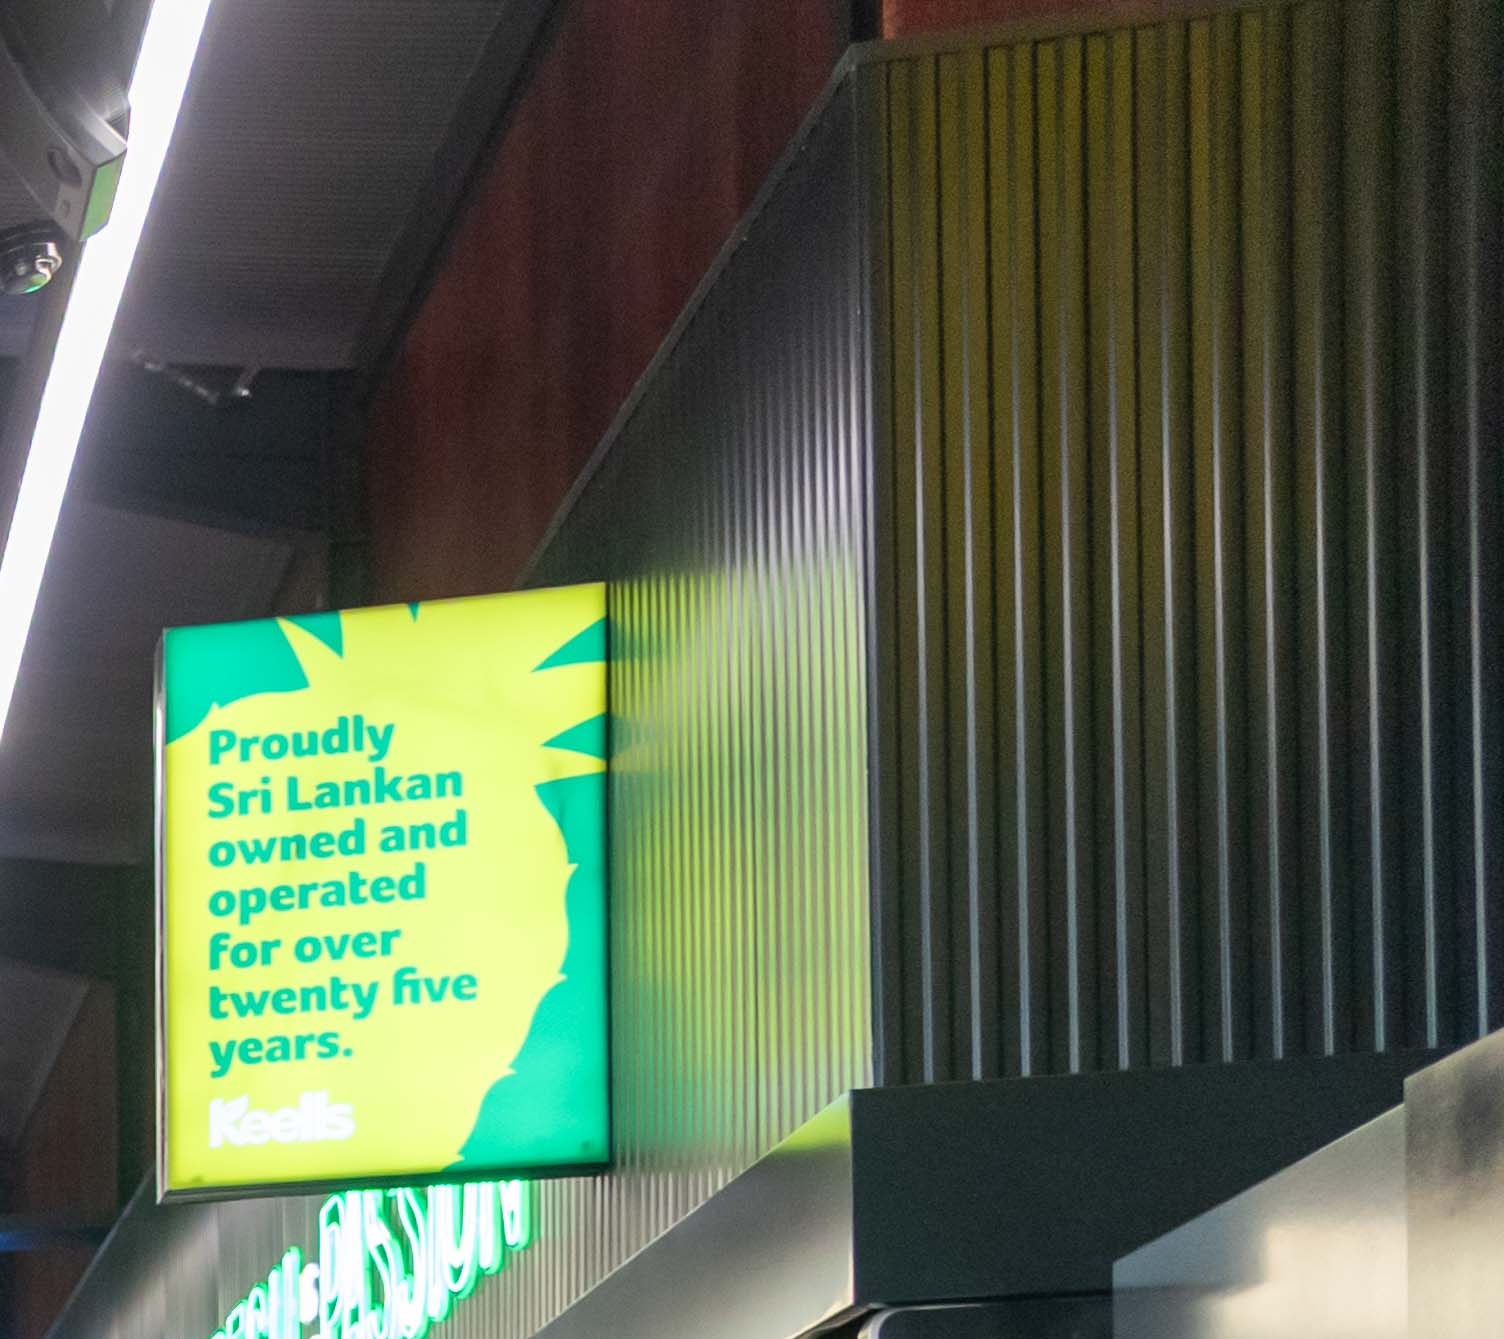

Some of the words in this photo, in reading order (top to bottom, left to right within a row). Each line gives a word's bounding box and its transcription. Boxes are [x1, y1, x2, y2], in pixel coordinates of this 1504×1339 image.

[209, 715, 395, 764] Proudly
[208, 777, 272, 819] Sri
[287, 766, 464, 811] Lankan
[208, 817, 366, 868] owned
[379, 808, 467, 853] and
[208, 861, 426, 926] operated
[209, 932, 282, 971] for
[294, 929, 402, 963] over
[209, 976, 379, 1020] twenty
[393, 966, 478, 1005] five
[209, 1031, 354, 1079] years.
[208, 1088, 356, 1148] Keells
